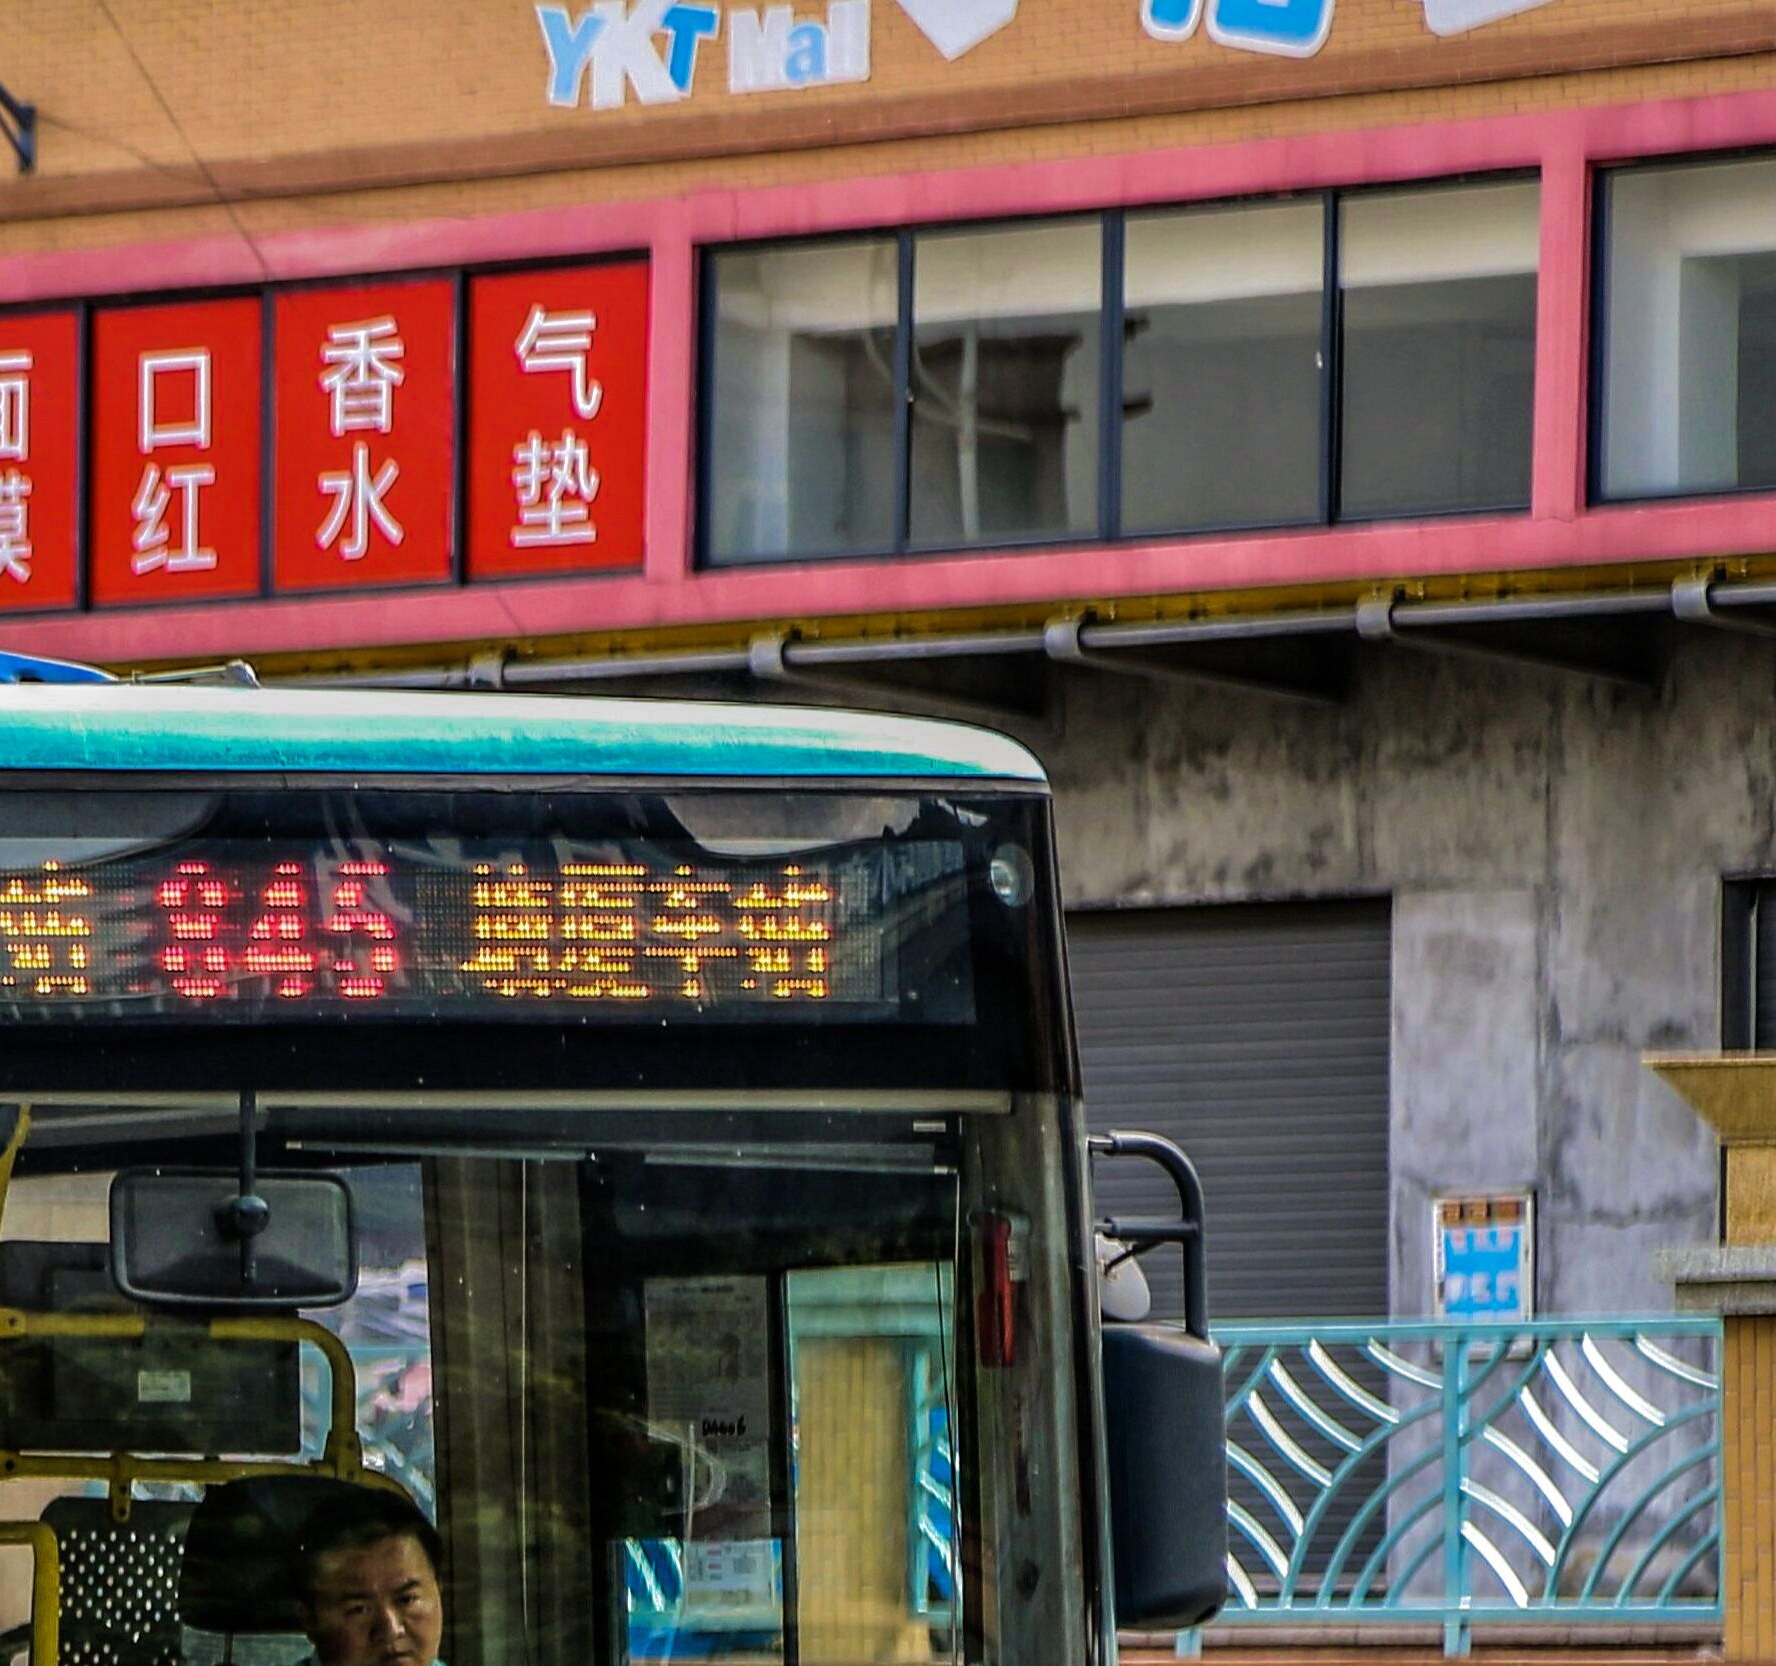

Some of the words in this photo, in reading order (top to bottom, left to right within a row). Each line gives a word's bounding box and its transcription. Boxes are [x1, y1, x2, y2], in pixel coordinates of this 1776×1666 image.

[535, 0, 720, 110] YKT
[131, 345, 218, 576] 口红
[317, 315, 405, 560] 香水
[511, 304, 602, 548] 气垫
[160, 862, 396, 998] 845
[461, 863, 829, 998] 塘厦车站
